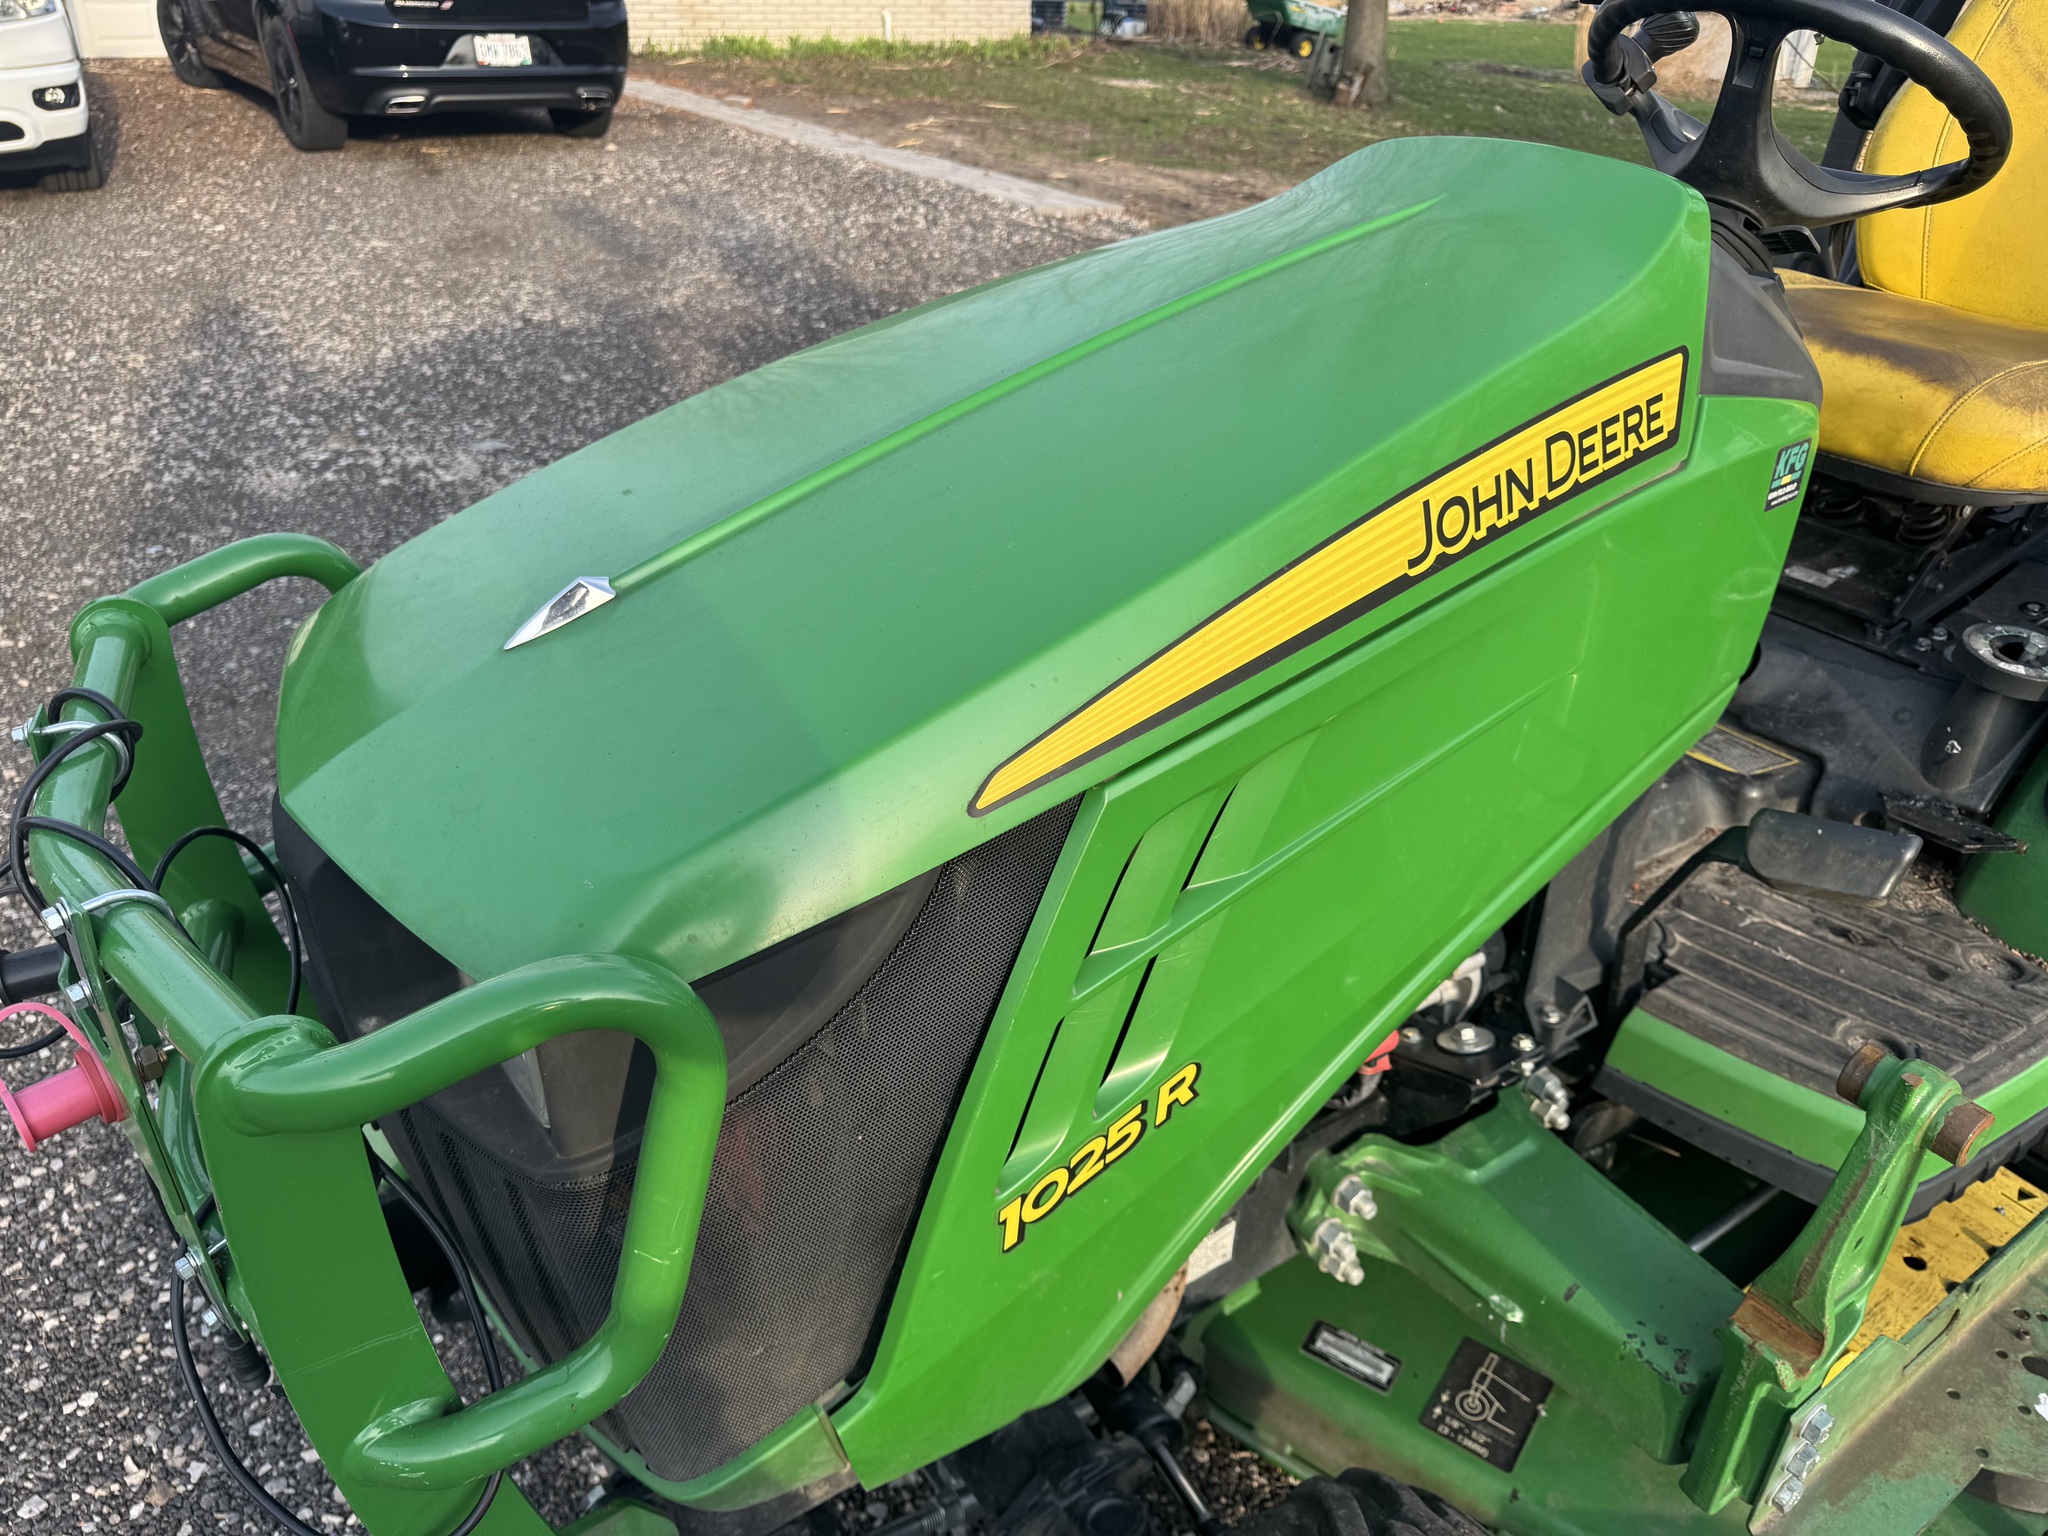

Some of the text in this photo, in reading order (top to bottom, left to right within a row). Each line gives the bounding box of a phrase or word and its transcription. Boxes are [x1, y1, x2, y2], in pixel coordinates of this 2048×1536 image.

[1406, 391, 1666, 572] JOHN DEERE
[1774, 441, 1810, 479] KFG
[997, 1099, 1149, 1253] 1025
[1153, 1061, 1203, 1129] R
